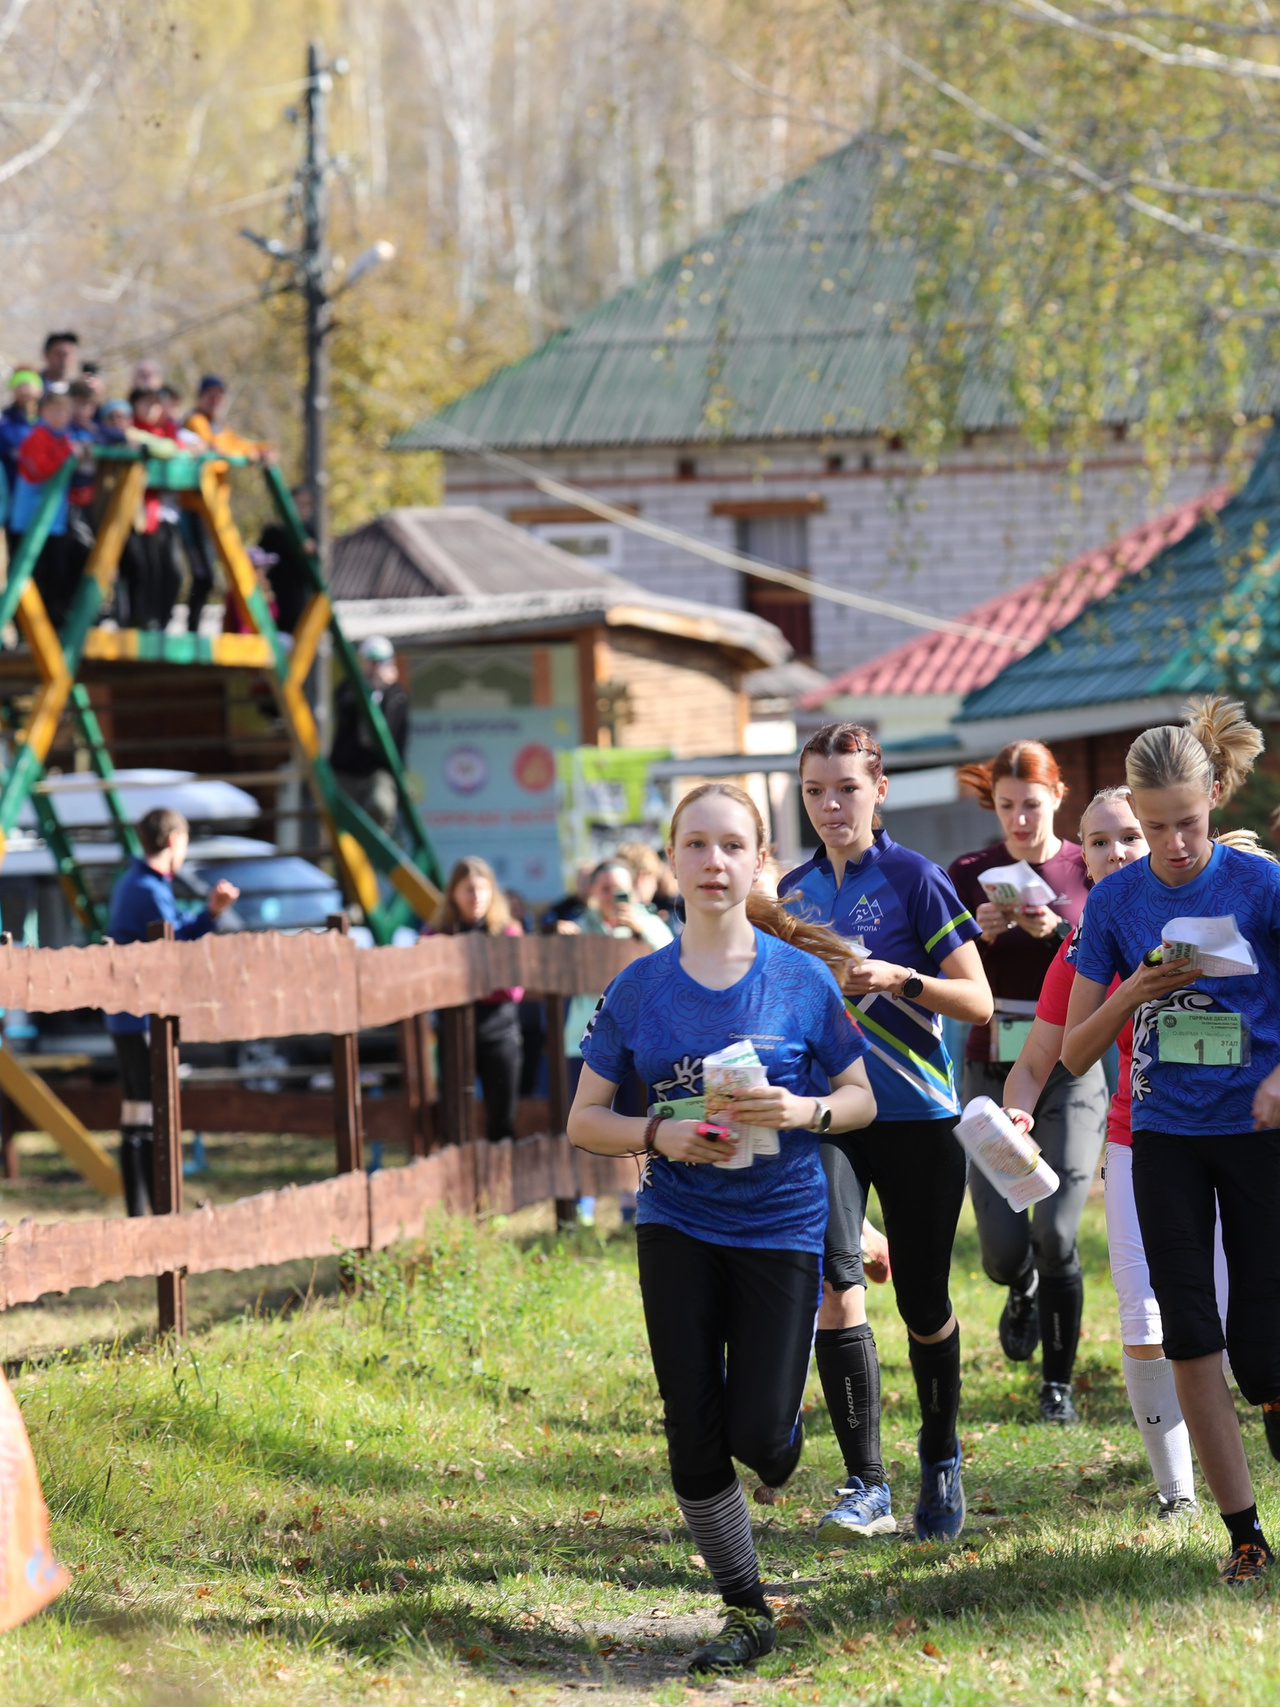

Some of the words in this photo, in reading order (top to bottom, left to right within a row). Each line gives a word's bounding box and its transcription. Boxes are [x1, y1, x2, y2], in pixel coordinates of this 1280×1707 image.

[1194, 1039, 1205, 1065] 1
[1227, 1048, 1233, 1065] 1
[844, 1376, 856, 1416] NORD
